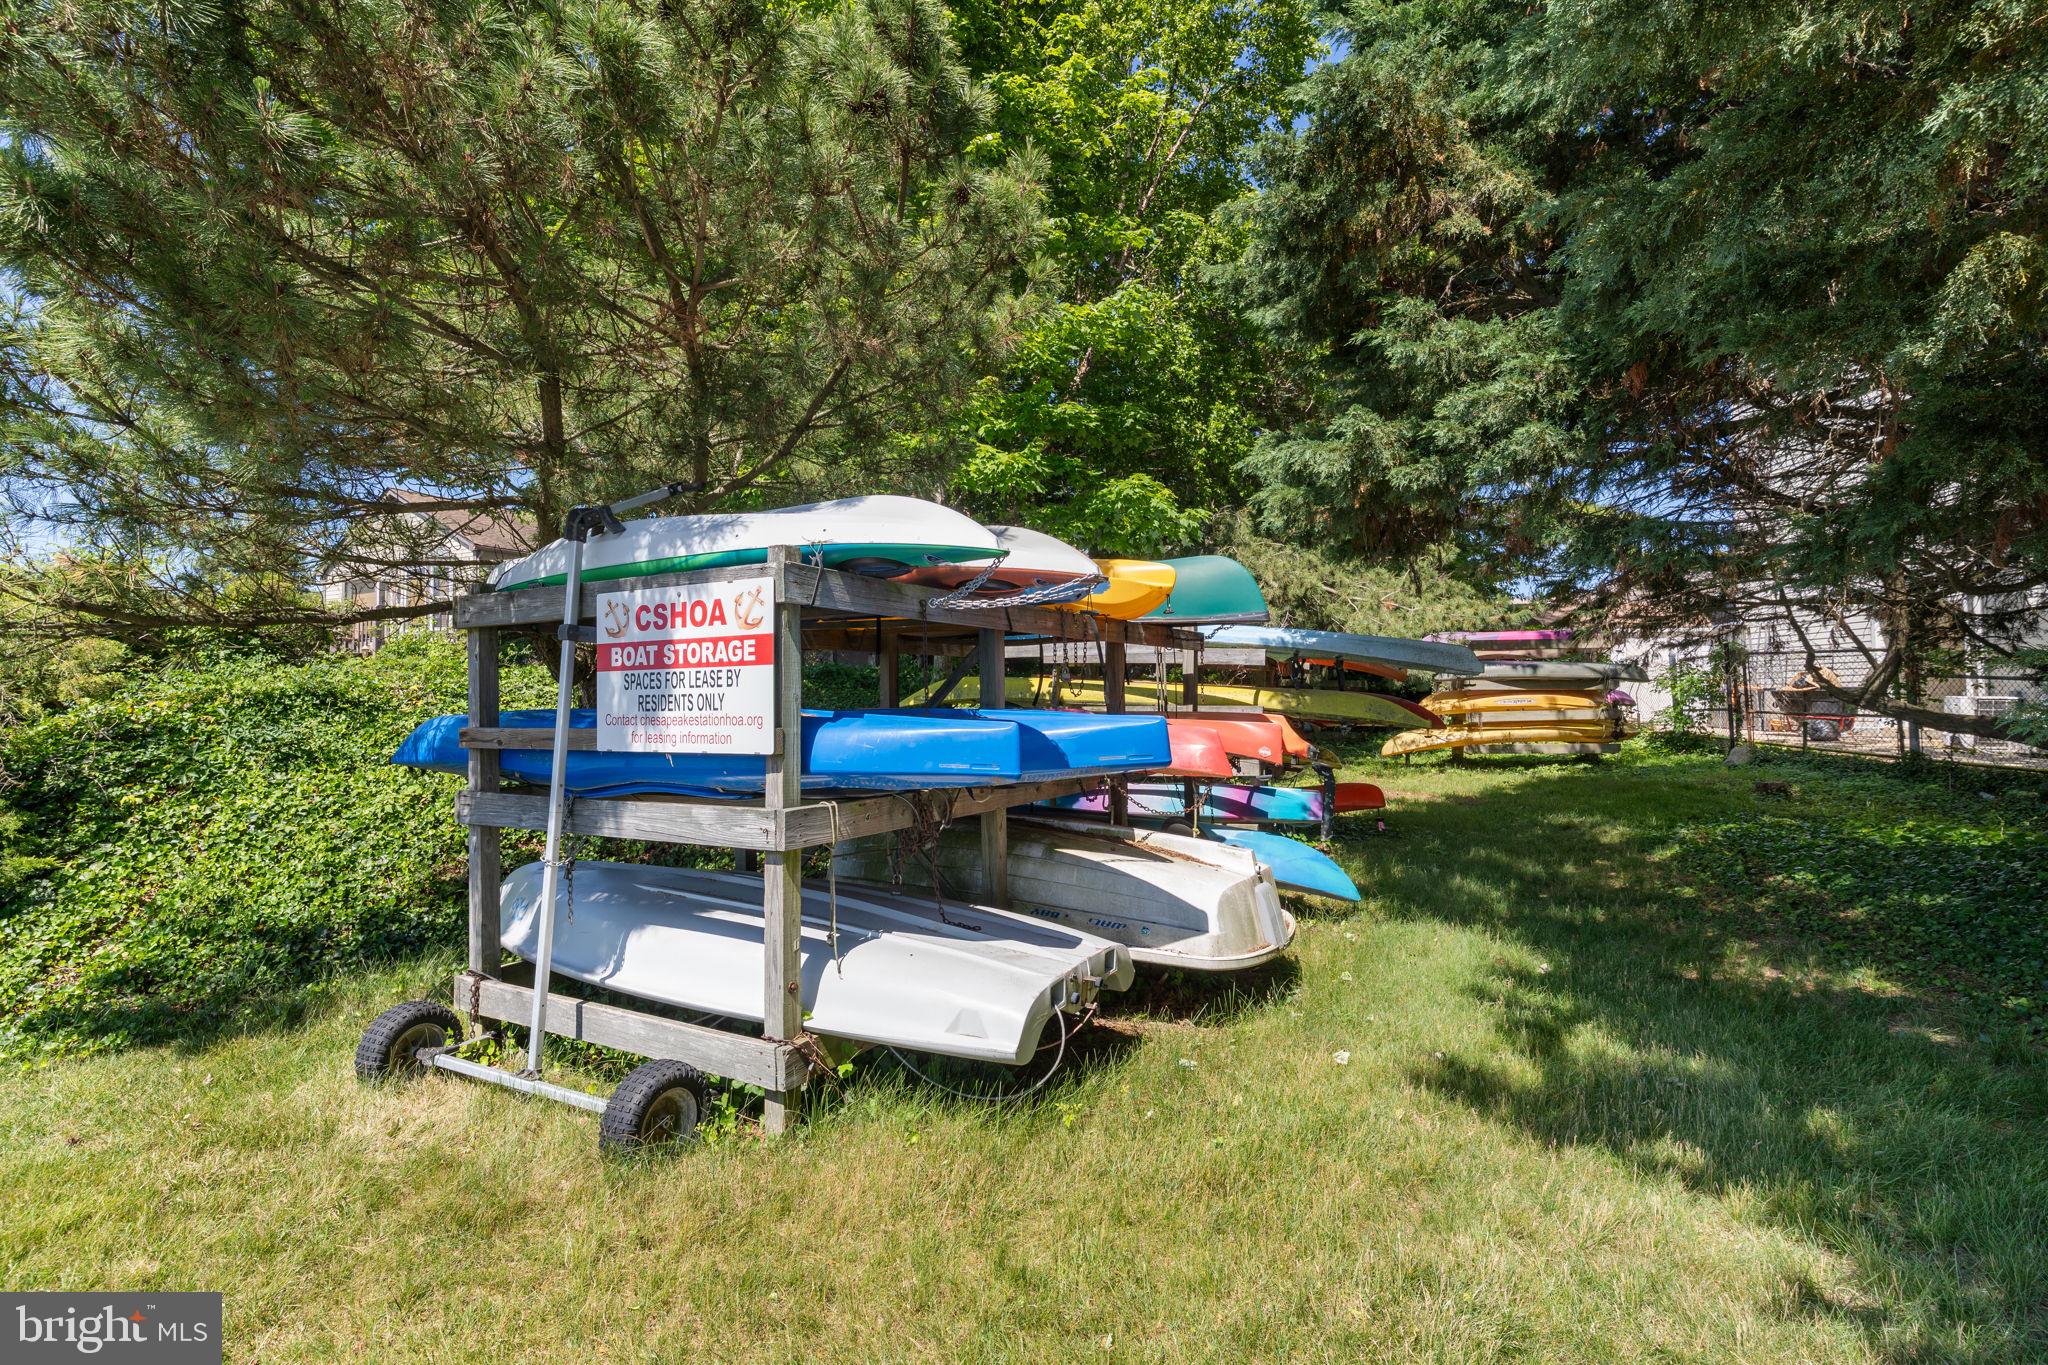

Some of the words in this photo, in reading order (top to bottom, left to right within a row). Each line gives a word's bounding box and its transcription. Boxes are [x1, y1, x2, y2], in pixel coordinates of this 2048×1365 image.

[636, 599, 727, 631] CSHOA
[611, 644, 659, 667] BOAT
[663, 639, 756, 665] STORAGE
[623, 671, 662, 691] SPACES
[665, 671, 686, 690] FOR
[688, 669, 723, 689] LEASE
[726, 668, 741, 688] BY
[638, 693, 694, 713] RESIDENTS
[697, 693, 725, 712] ONLY
[605, 713, 638, 727] Contact
[640, 713, 764, 729] chesapeakestationhoa.org
[631, 731, 643, 745] for
[645, 732, 677, 748] leasing
[679, 731, 732, 745] information
